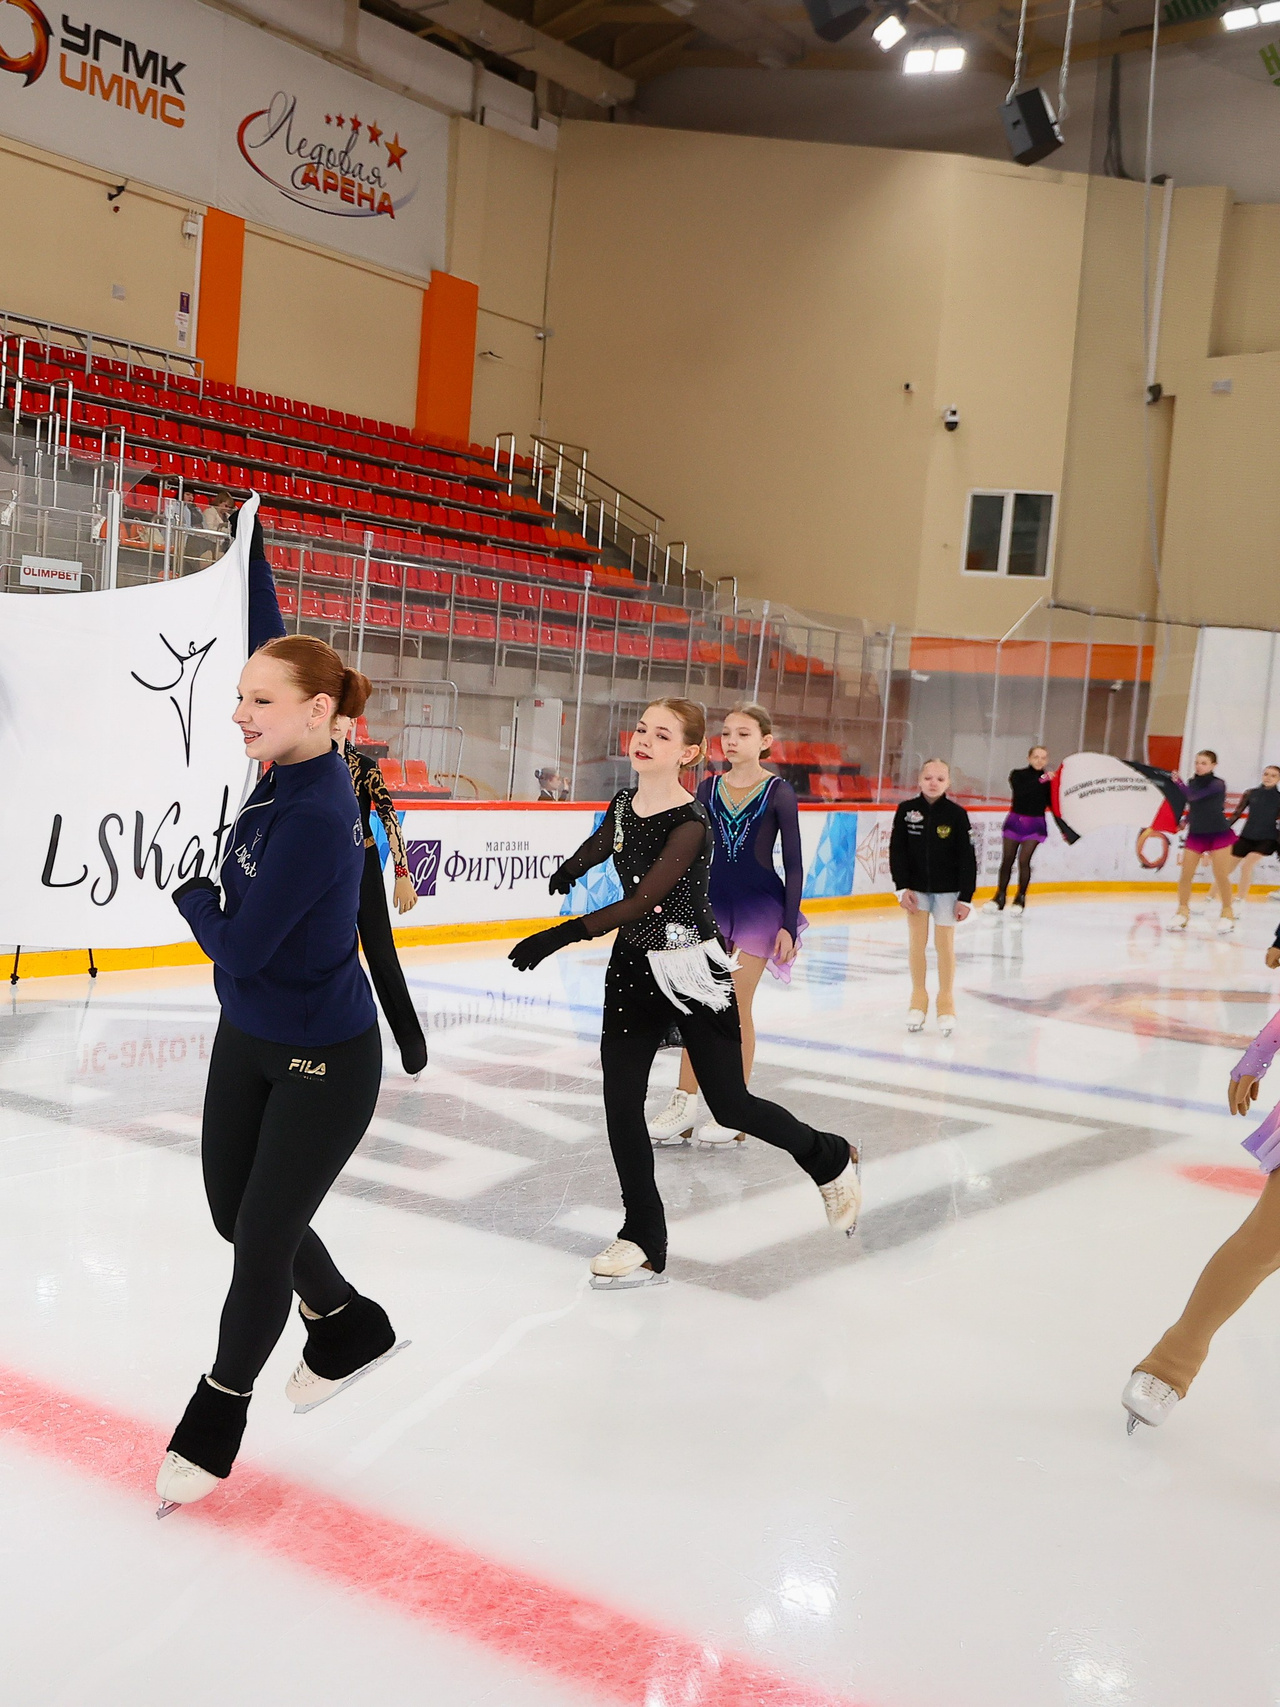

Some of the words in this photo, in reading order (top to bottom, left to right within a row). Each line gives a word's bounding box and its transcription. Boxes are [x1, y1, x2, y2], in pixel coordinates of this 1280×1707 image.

[60, 13, 187, 96] УГМК
[59, 52, 186, 128] UMMC
[248, 91, 387, 190] Ледовая
[300, 162, 396, 219] АРЕНА
[23, 566, 79, 582] OLIMPBET
[41, 785, 232, 907] LSKat
[444, 850, 565, 890] Фигурист
[485, 841, 530, 852] магазин
[288, 1058, 326, 1076] FILA
